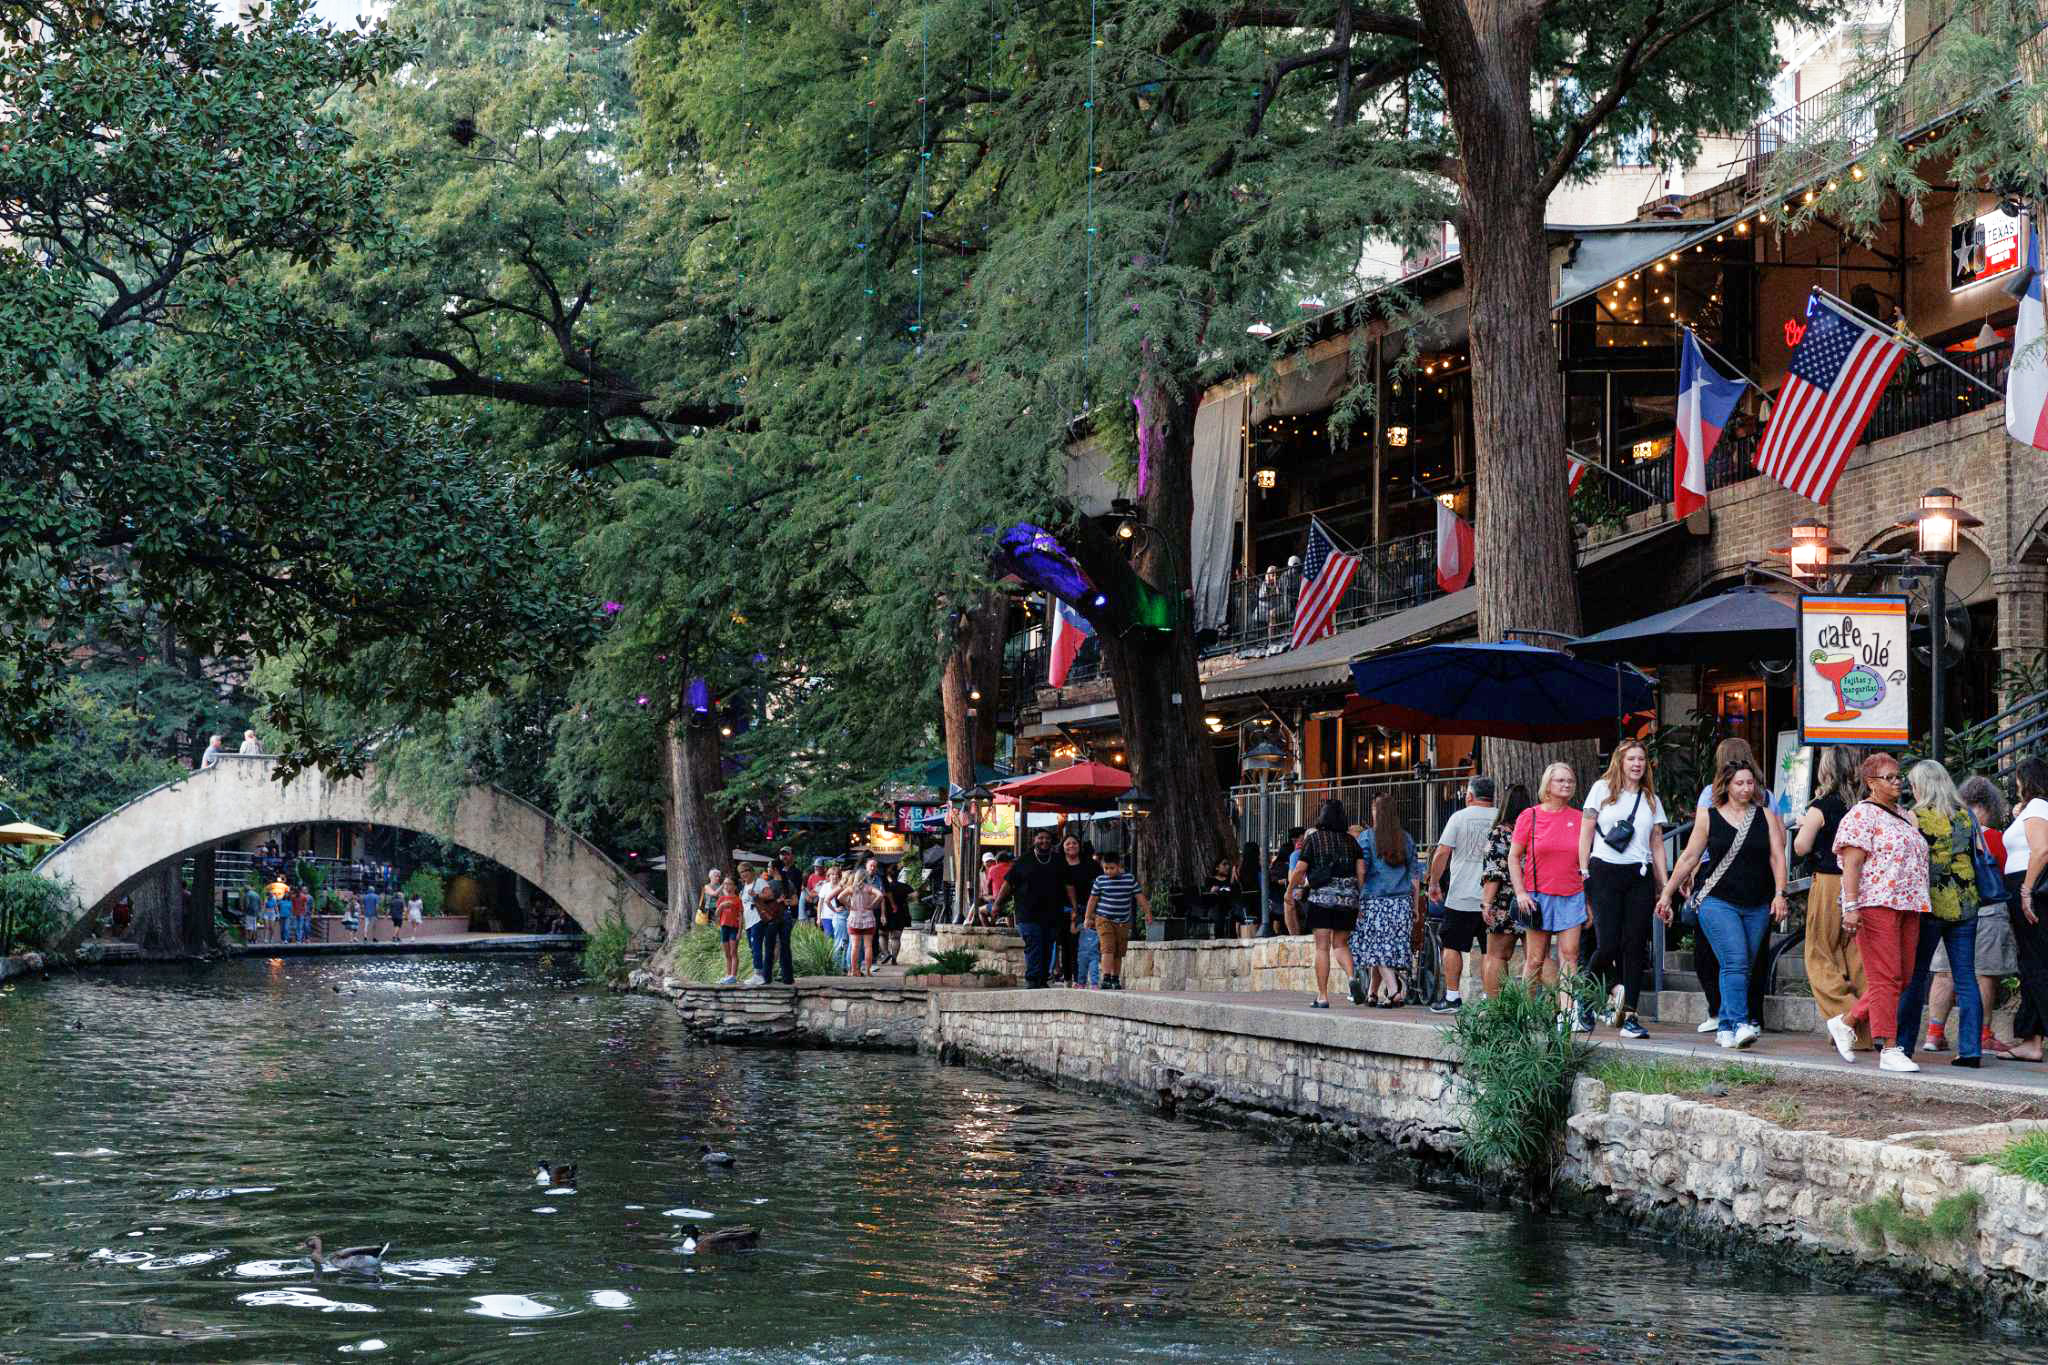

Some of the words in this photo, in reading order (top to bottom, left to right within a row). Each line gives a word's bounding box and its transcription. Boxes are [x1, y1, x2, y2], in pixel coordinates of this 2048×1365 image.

[1987, 221, 2014, 240] TEXAS
[1818, 615, 1862, 649] cafe
[1862, 632, 1891, 667] olé
[1843, 685, 1877, 695] margaritas
